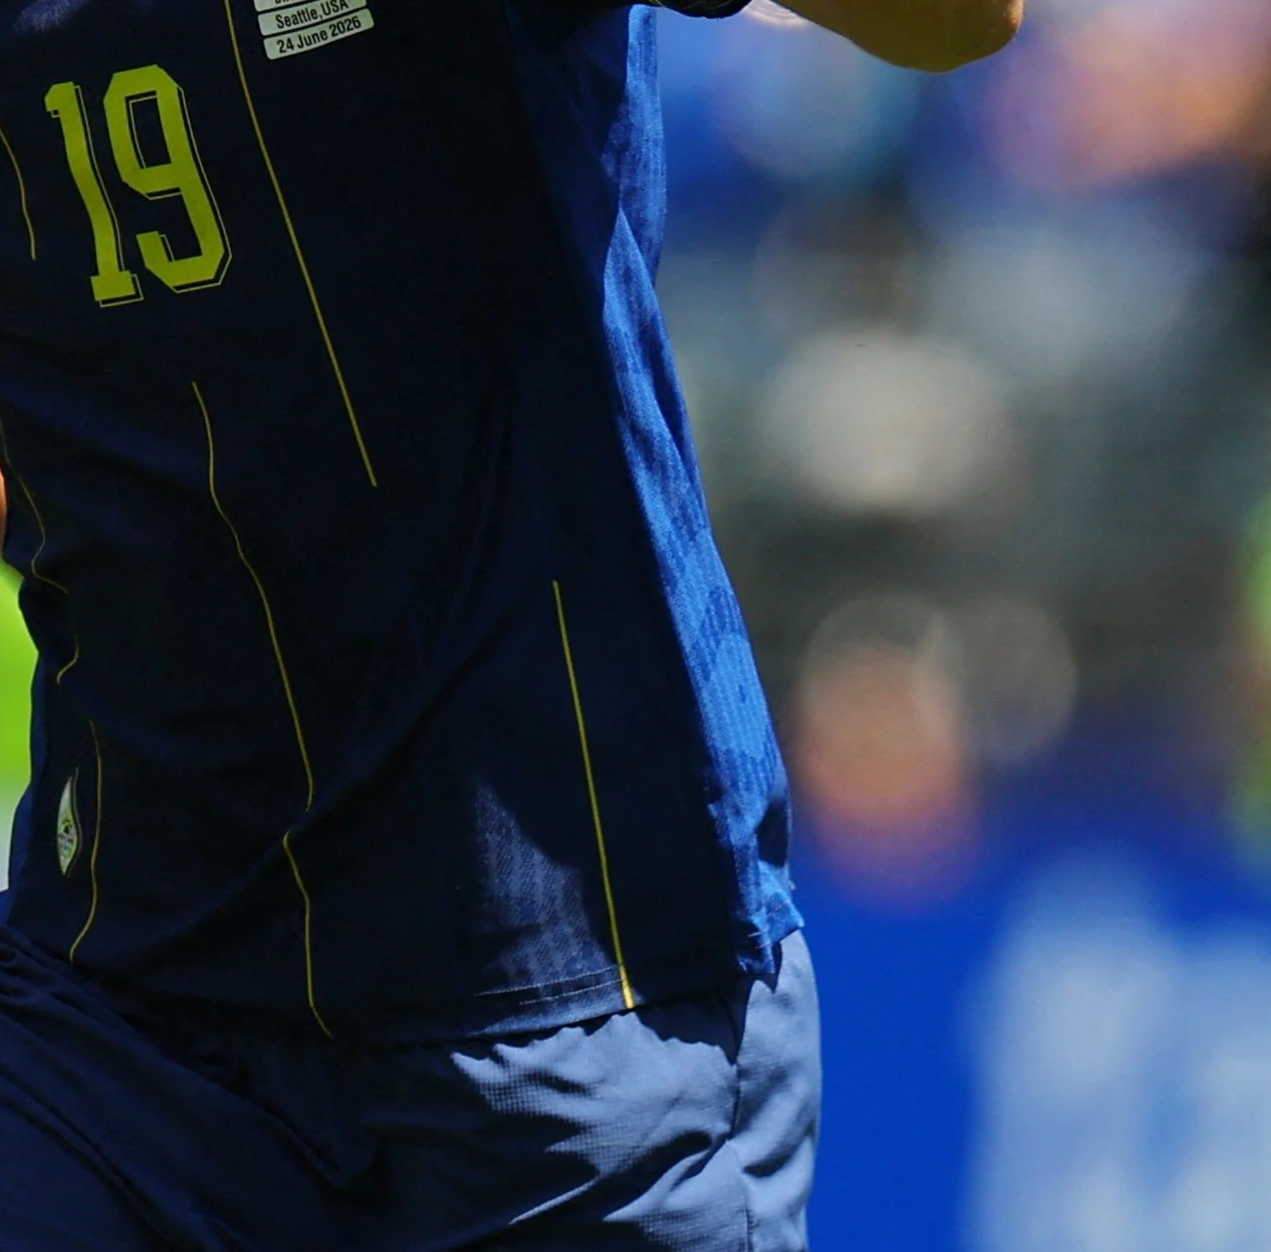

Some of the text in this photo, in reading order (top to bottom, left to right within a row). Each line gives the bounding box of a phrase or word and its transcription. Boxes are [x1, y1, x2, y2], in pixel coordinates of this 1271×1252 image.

[277, 15, 362, 54] 24 June 2026
[44, 63, 233, 308] 19
